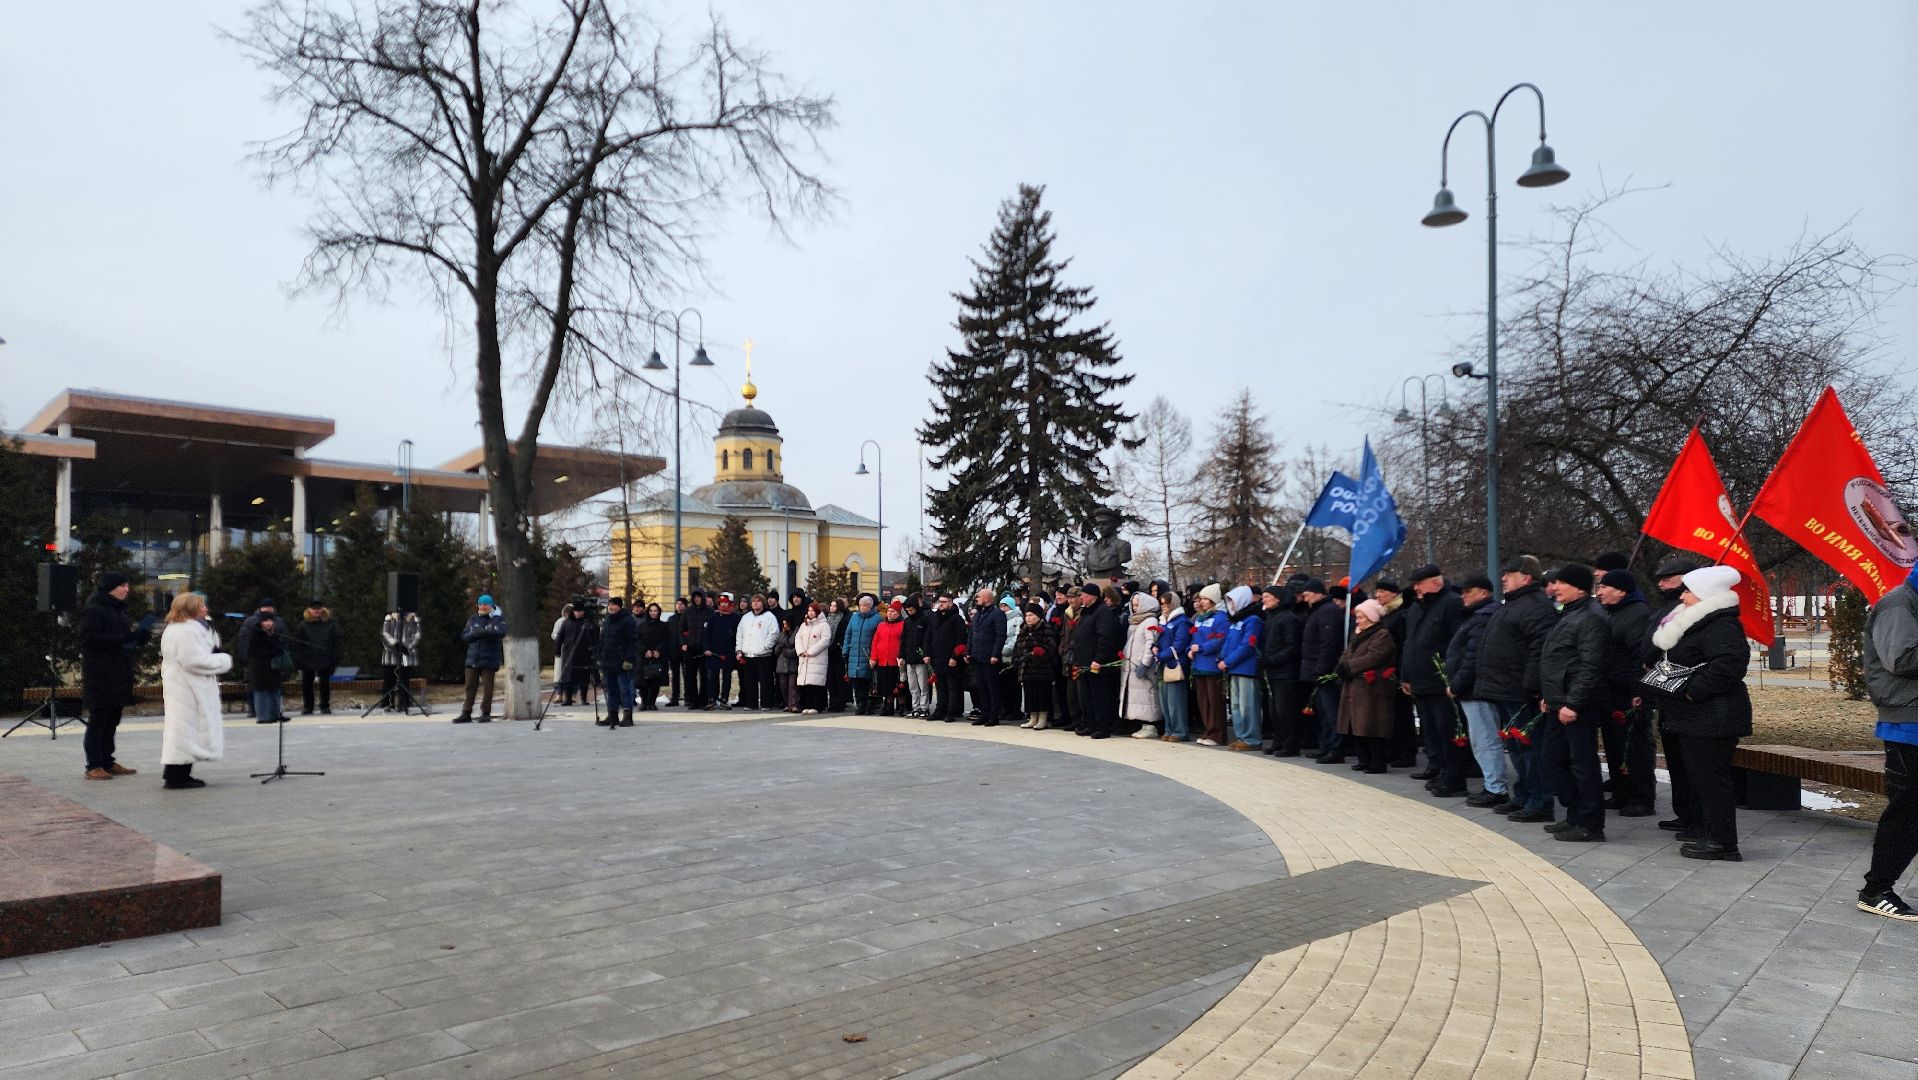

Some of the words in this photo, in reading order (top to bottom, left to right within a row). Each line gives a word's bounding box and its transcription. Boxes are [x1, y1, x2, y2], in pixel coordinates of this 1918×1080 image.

[1693, 527, 1715, 540] ВО
[1804, 517, 1826, 535] ВО
[1823, 531, 1864, 560] ИМЯ
